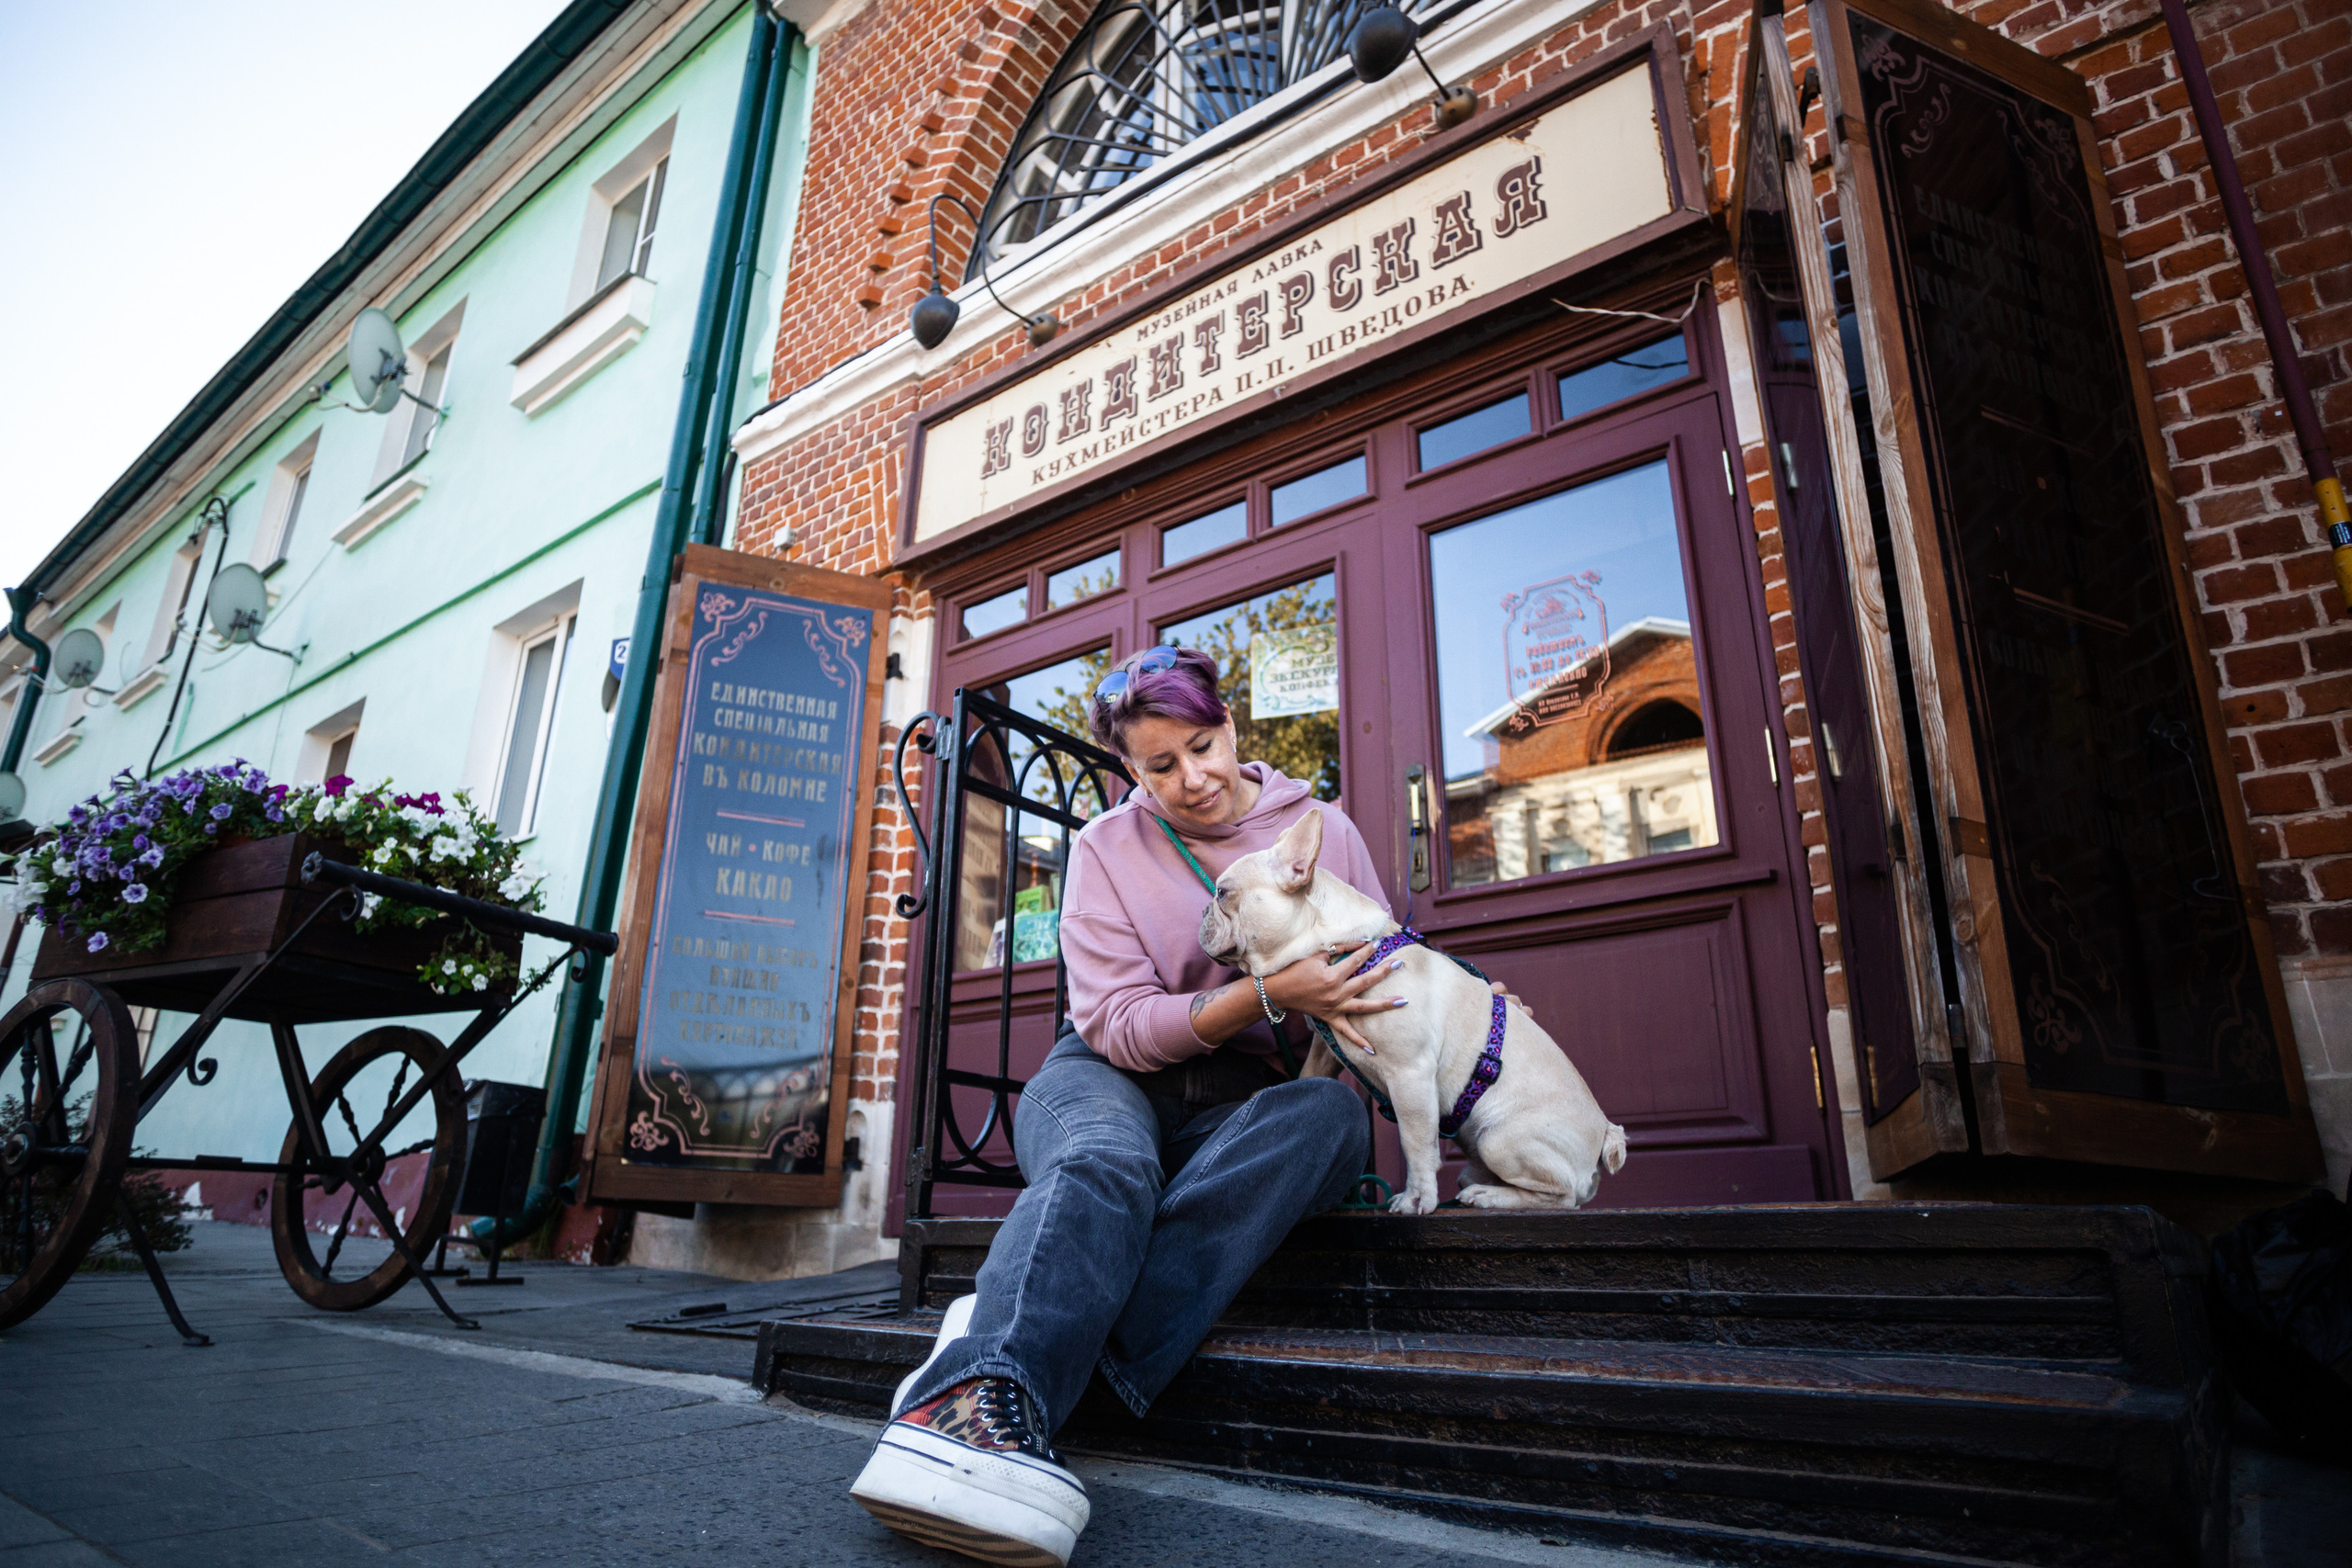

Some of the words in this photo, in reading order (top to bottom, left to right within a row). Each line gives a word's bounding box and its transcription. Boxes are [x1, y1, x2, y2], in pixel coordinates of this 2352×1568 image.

[1136, 278, 1239, 343] МУЗЕЙНАЯ
[1252, 238, 1324, 284] ЛАВКА
[980, 154, 1548, 480] КОНДИТЕРСКАЯ
[1030, 384, 1225, 487] КУХМЕЙСТЕРА
[710, 681, 838, 721] ЕДИНСТВЕННАЯ
[692, 732, 842, 775] КОНДИТЕРСКАЯ
[702, 763, 729, 789] ВЪ
[737, 769, 828, 803] КОЛОМНЕ
[707, 831, 742, 857] ЧАЙ
[762, 839, 811, 866] КОФЕ
[715, 867, 793, 903] КАКАО
[672, 934, 751, 962] БОЛЬШОЙ
